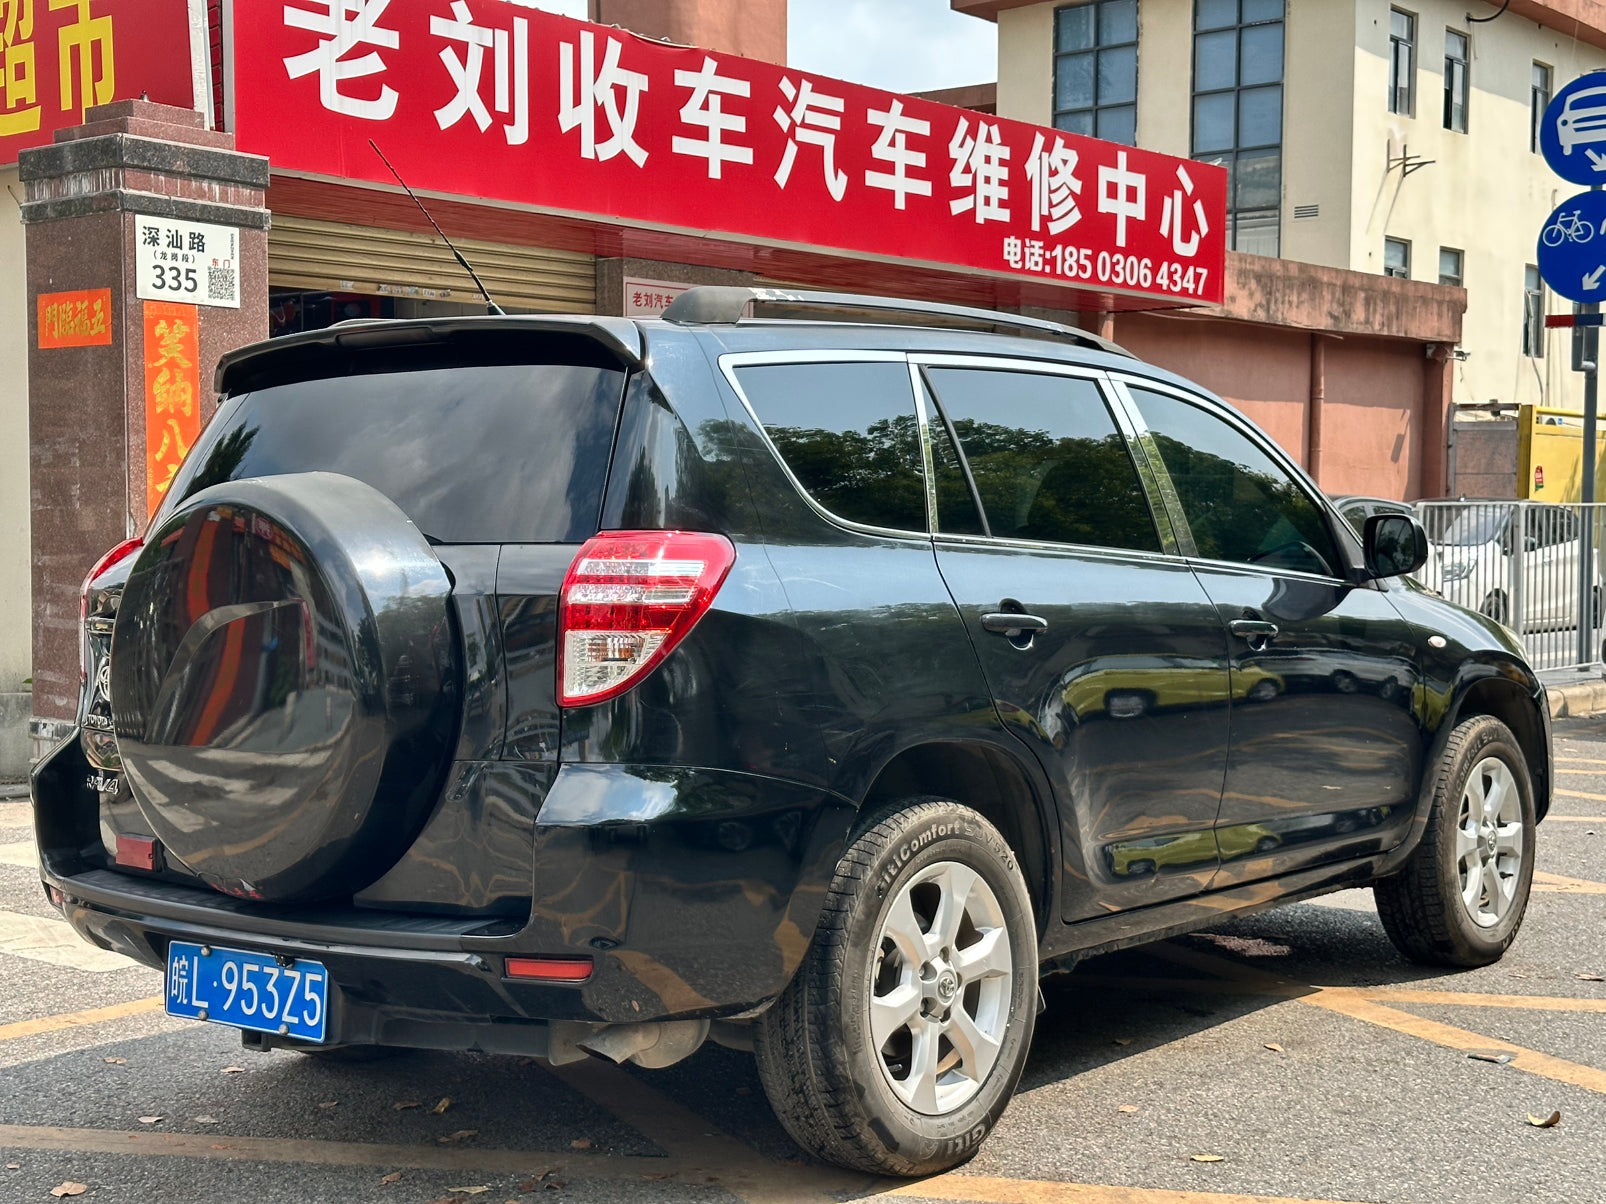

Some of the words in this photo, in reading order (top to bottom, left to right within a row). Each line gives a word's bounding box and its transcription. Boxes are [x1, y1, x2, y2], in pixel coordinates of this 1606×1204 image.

[283, 0, 1209, 257] 老刘收车汽车维修中心
[142, 225, 206, 254] 深汕路
[152, 264, 198, 293] 335
[1097, 251, 1153, 288] 0306
[1155, 261, 1209, 296] 4347
